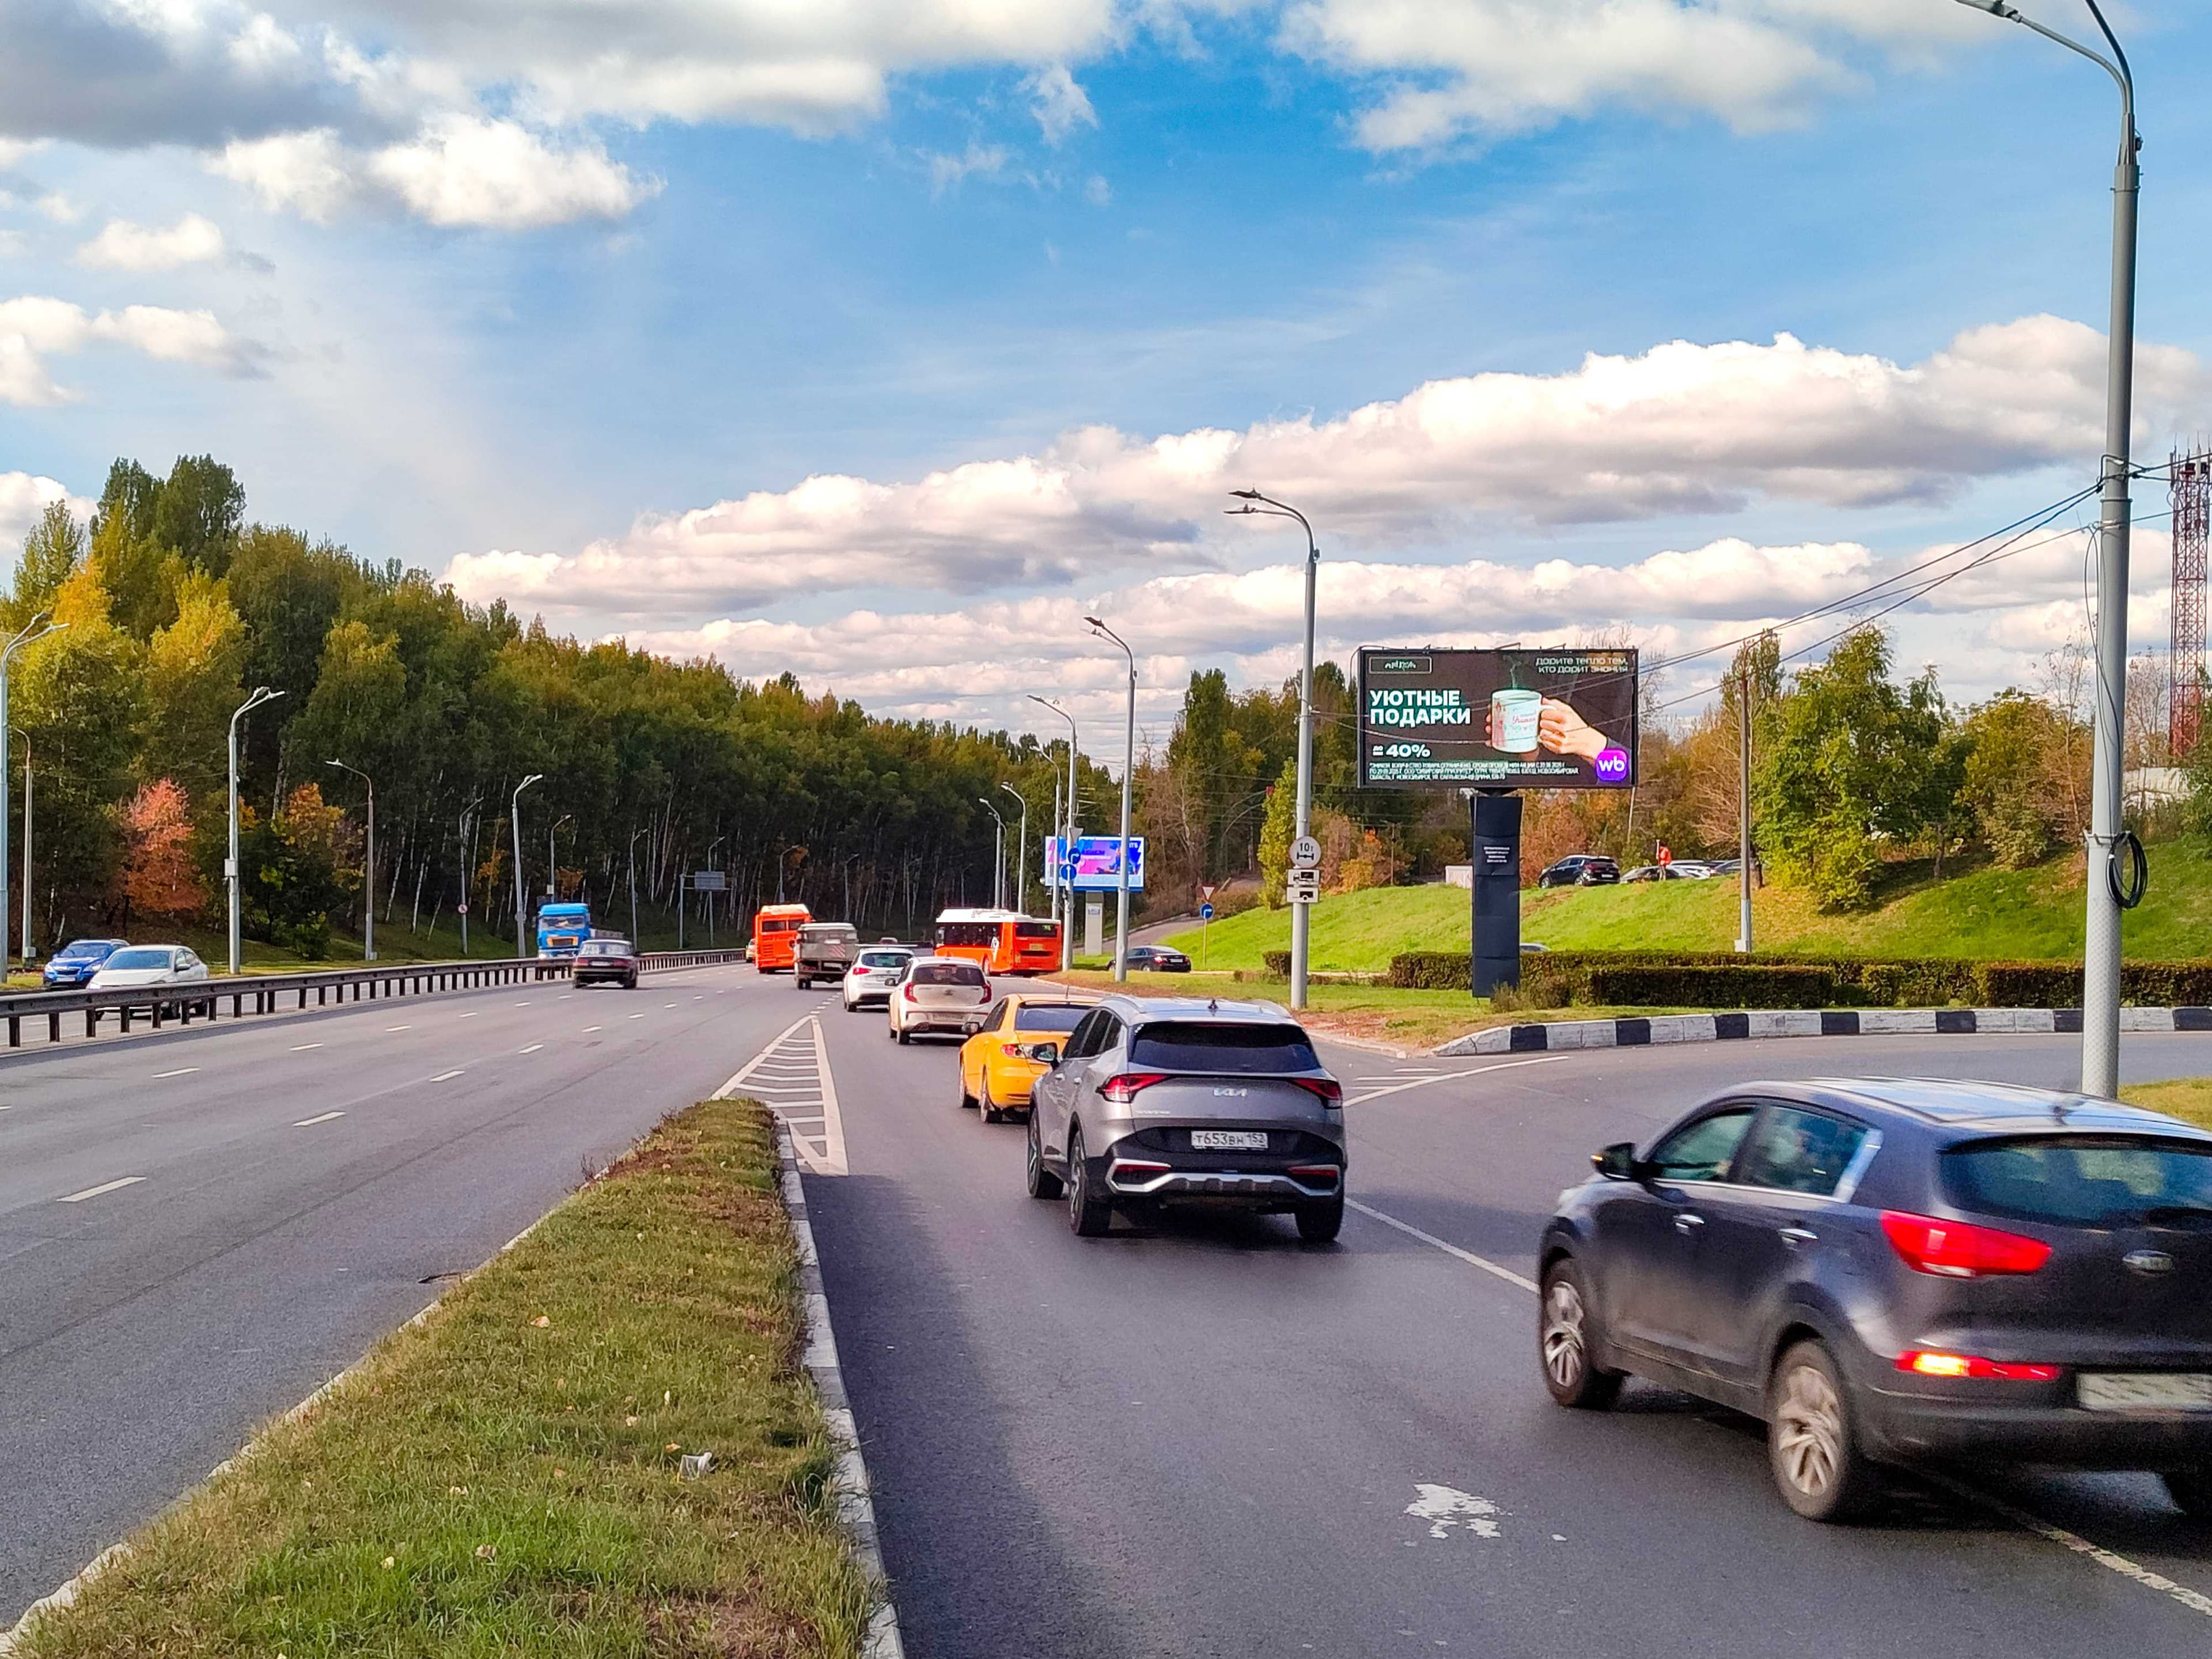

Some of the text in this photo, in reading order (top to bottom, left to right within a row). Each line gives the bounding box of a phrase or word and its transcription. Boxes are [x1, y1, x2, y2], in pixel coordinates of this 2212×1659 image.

[1369, 690, 1460, 706] УЮТНЫЕ
[1370, 708, 1471, 728] ПОДАРКИ
[1598, 755, 1625, 772] wb
